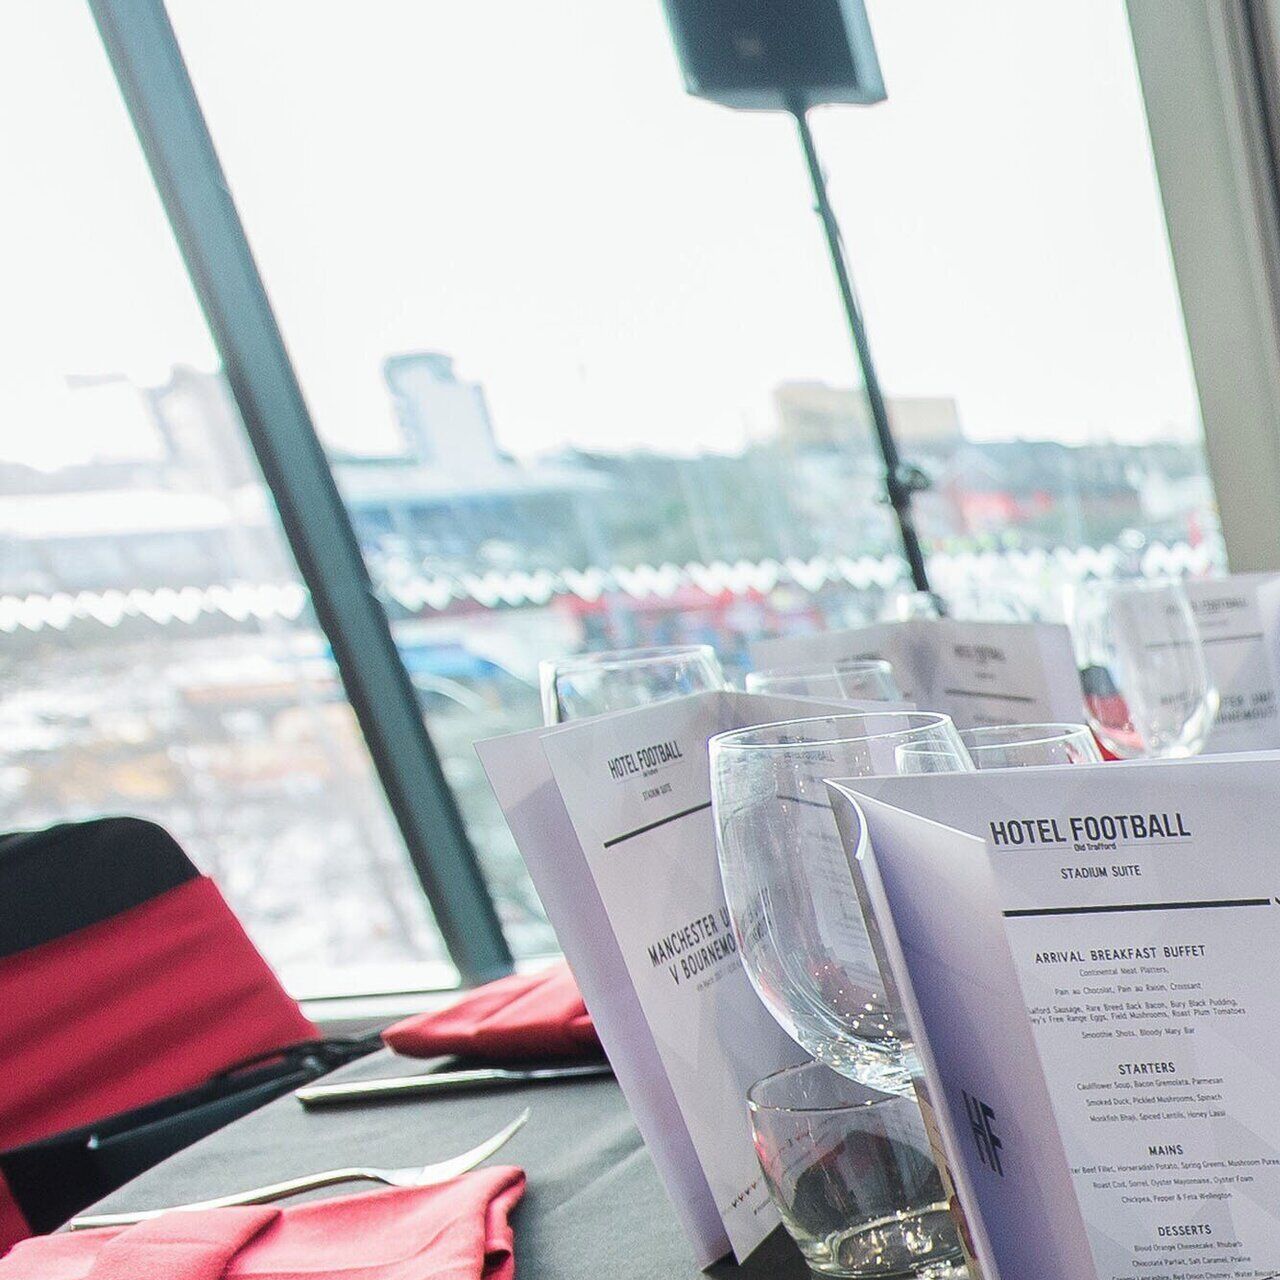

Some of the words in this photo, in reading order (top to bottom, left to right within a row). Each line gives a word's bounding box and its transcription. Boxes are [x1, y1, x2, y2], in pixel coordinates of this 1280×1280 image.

[608, 752, 640, 779] HOTEL
[636, 740, 683, 770] FOOTBALL
[990, 819, 1067, 845] HOTEL
[1070, 813, 1191, 841] FOOTBALL
[1061, 866, 1108, 879] STADIUM
[1111, 864, 1142, 877] SUITE
[647, 913, 718, 967] MANCHESTER
[1035, 950, 1085, 964] ARRIVAL
[1090, 947, 1157, 961] BREAKFAST
[1164, 944, 1206, 958] BUFFET
[669, 964, 679, 985] V
[1118, 1061, 1176, 1075] STARTERS
[1134, 1079, 1154, 1088] Bacon
[1192, 1077, 1224, 1086] Parmesan
[1085, 1098, 1112, 1107] Smoked
[1113, 1097, 1132, 1106] Duck,
[1132, 1096, 1155, 1105] Pickled
[1139, 1112, 1161, 1121] Spiced
[1187, 1110, 1207, 1120] Honey
[1148, 1144, 1184, 1156] MAINS
[1082, 1166, 1097, 1174] Beef
[1180, 1161, 1202, 1171] Spring
[1227, 1159, 1261, 1167] Mushroom
[1158, 1224, 1212, 1237] DESSERTS
[1172, 1273, 1185, 1280] Red
